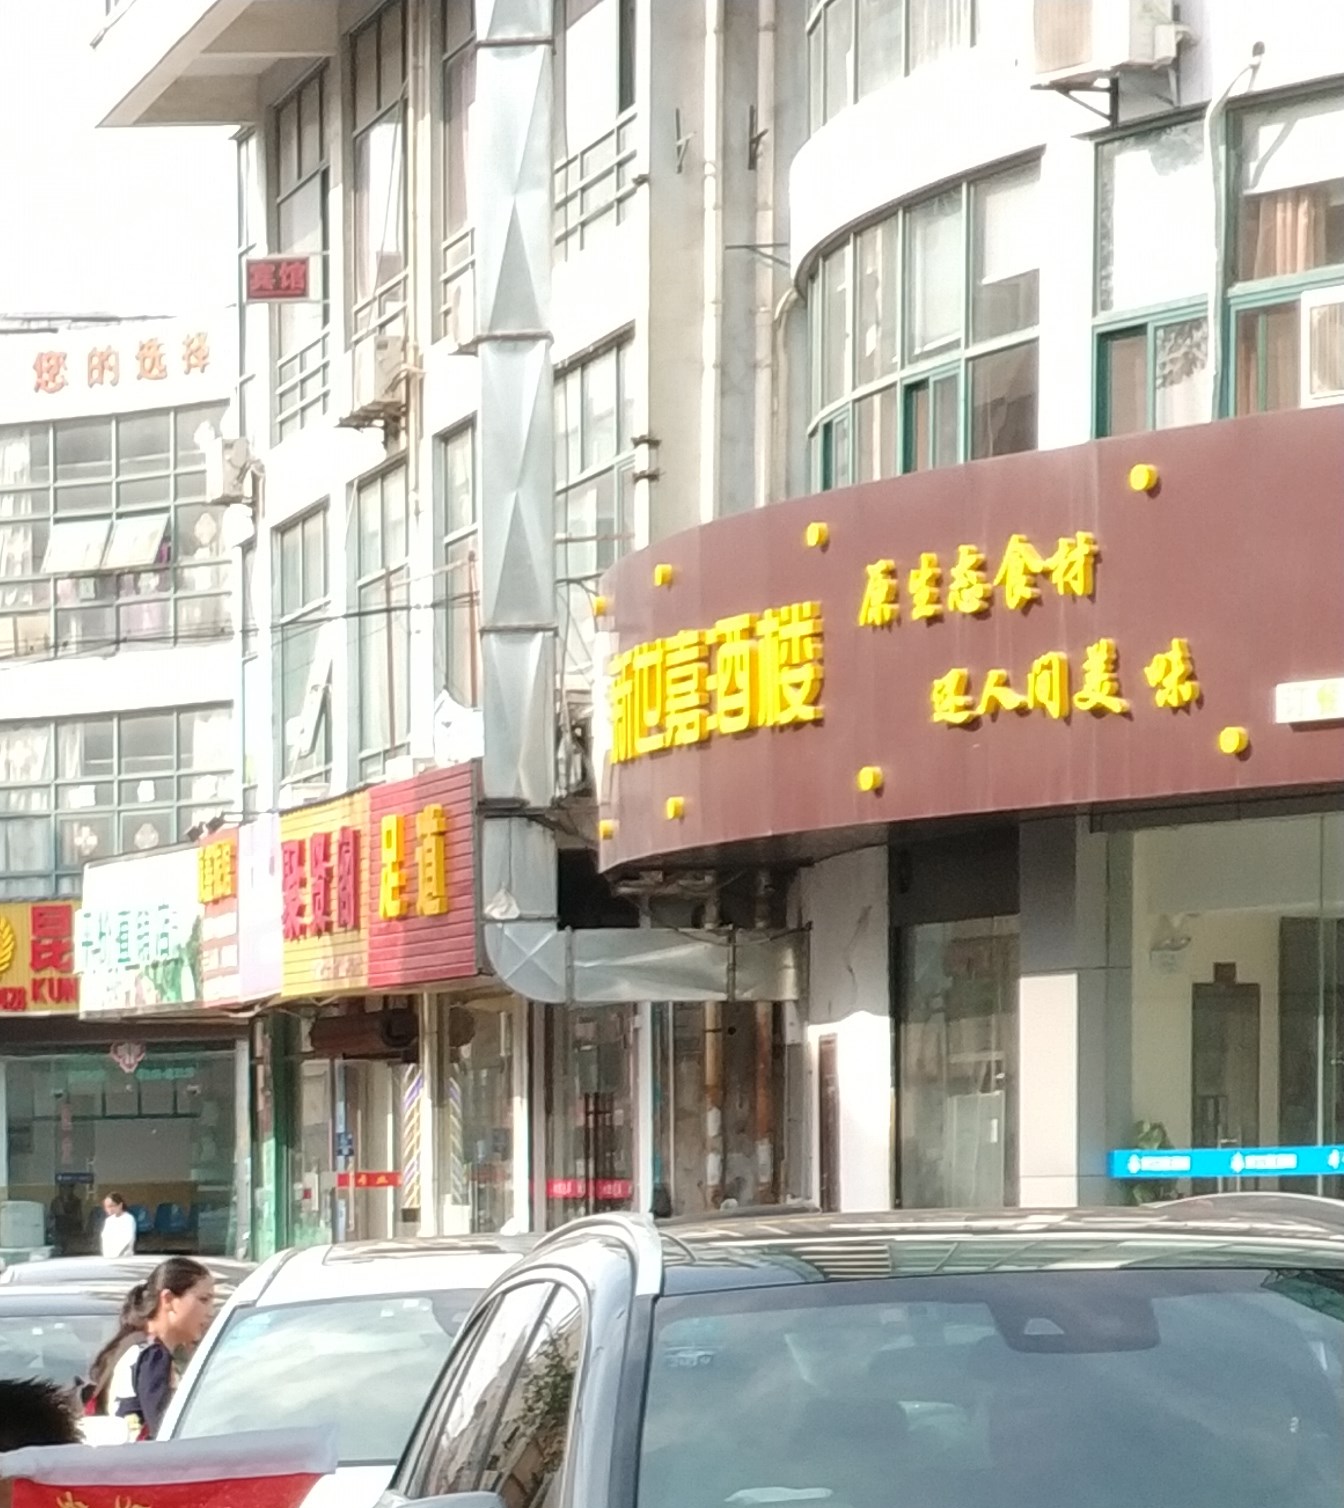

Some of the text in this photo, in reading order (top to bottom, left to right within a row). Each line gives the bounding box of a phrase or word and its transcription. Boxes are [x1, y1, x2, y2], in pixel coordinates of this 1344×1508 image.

[858, 530, 1100, 627] 原生态食材
[609, 600, 824, 765] 新世嘉酒楼
[929, 637, 1202, 725] 还人间美味
